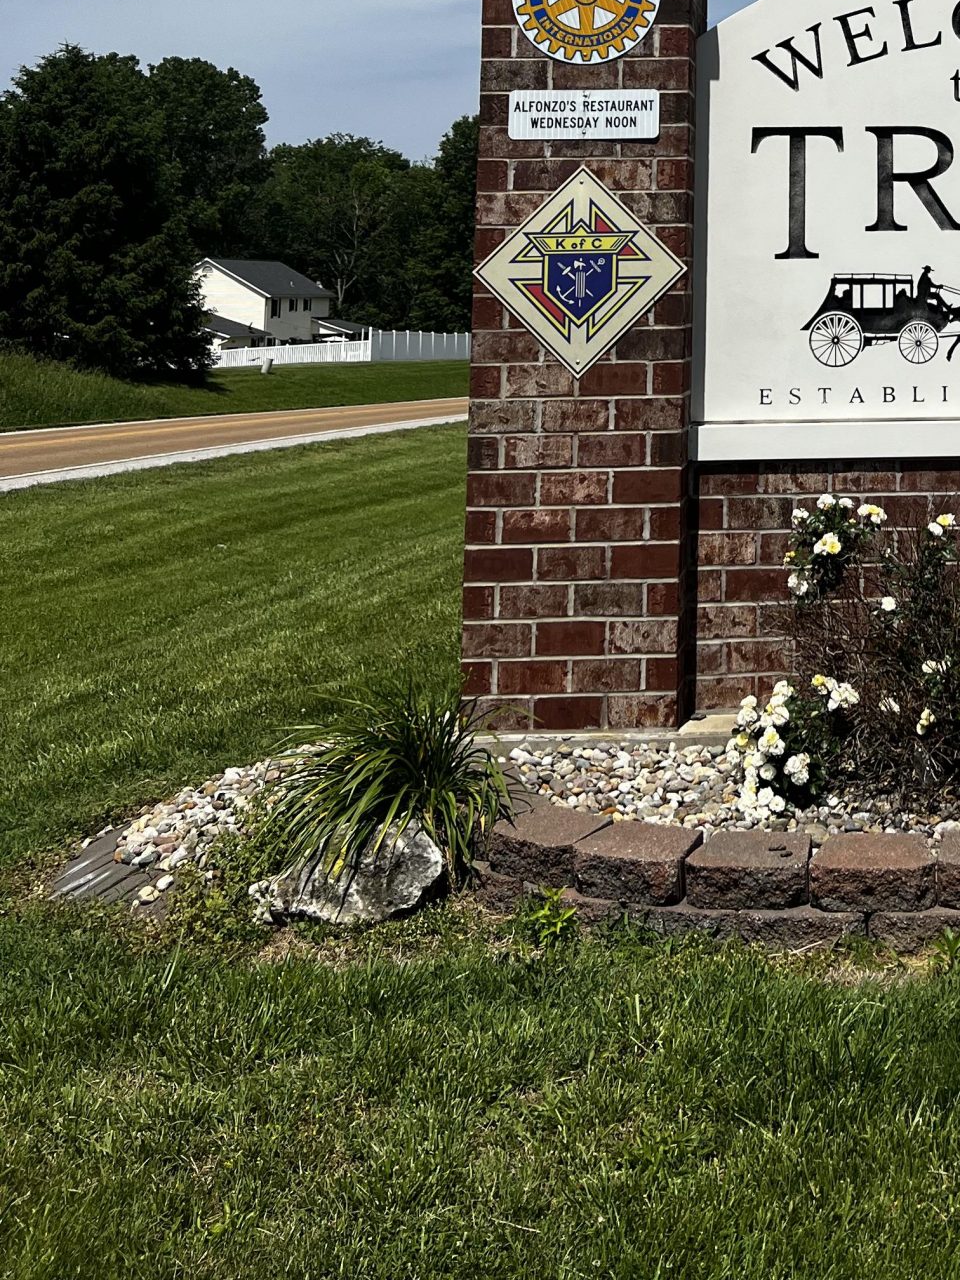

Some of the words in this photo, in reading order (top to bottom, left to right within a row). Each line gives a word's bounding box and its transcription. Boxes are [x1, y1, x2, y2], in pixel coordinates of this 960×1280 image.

[538, 15, 634, 47] INTERNATIONAL
[514, 100, 577, 113] ALFONZO'S
[582, 99, 655, 112] RESTAURANT
[530, 116, 600, 129] WEDNESDAY
[605, 116, 637, 128] NOON
[555, 238, 566, 250] K
[571, 238, 585, 250] of
[591, 237, 603, 249] C
